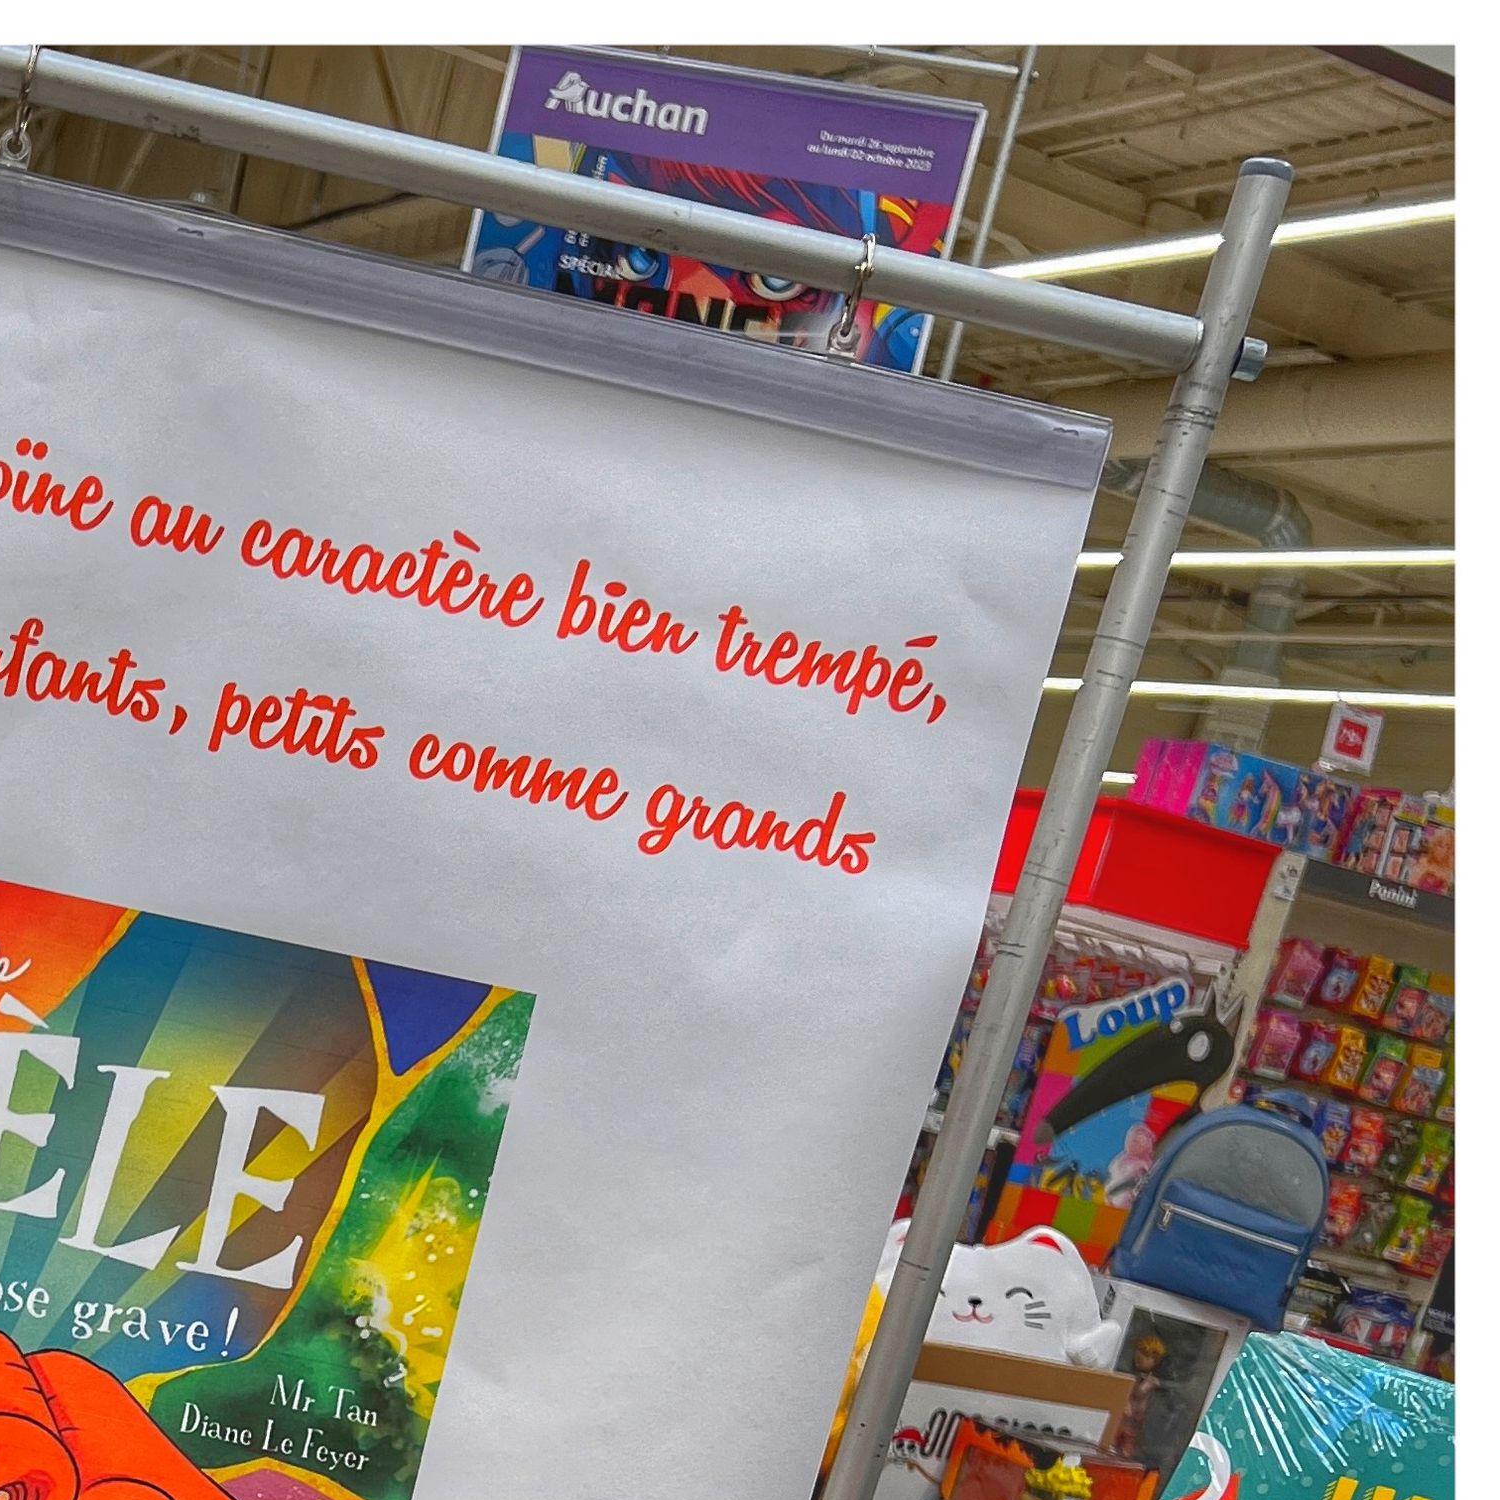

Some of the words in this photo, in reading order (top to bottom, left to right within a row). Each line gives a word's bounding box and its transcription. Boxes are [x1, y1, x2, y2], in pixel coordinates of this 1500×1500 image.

[545, 71, 709, 136] Auchan
[130, 495, 225, 555] au
[240, 518, 545, 628] caractère
[557, 559, 699, 655] bien
[714, 605, 947, 724] trempé,
[207, 681, 386, 770] petits
[408, 733, 630, 821] comme
[636, 783, 877, 876] grands
[1064, 983, 1188, 1052] Loup
[269, 1374, 317, 1413] Mr
[328, 1385, 378, 1428] Tan
[180, 1402, 252, 1446] Diane
[262, 1419, 294, 1454] Le
[301, 1428, 370, 1471] Feyer
